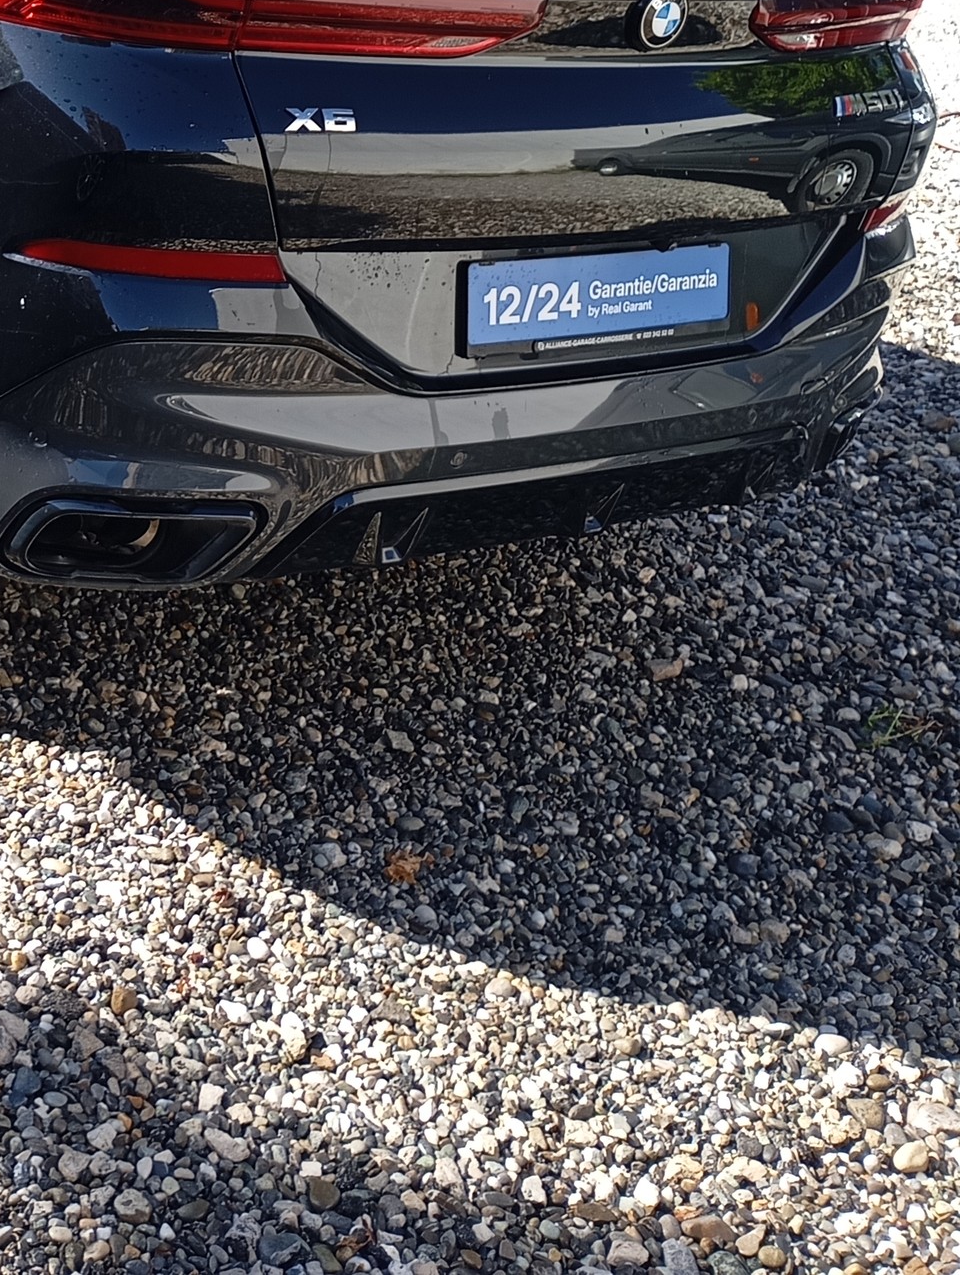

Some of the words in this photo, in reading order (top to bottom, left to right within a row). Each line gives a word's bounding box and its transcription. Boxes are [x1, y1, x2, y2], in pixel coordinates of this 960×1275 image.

[284, 107, 357, 132] X6
[589, 268, 718, 300] Garantie/Garanzia
[483, 281, 582, 326] 12/24
[587, 304, 600, 318] by
[601, 302, 622, 315] Real
[622, 299, 653, 313] Garant
